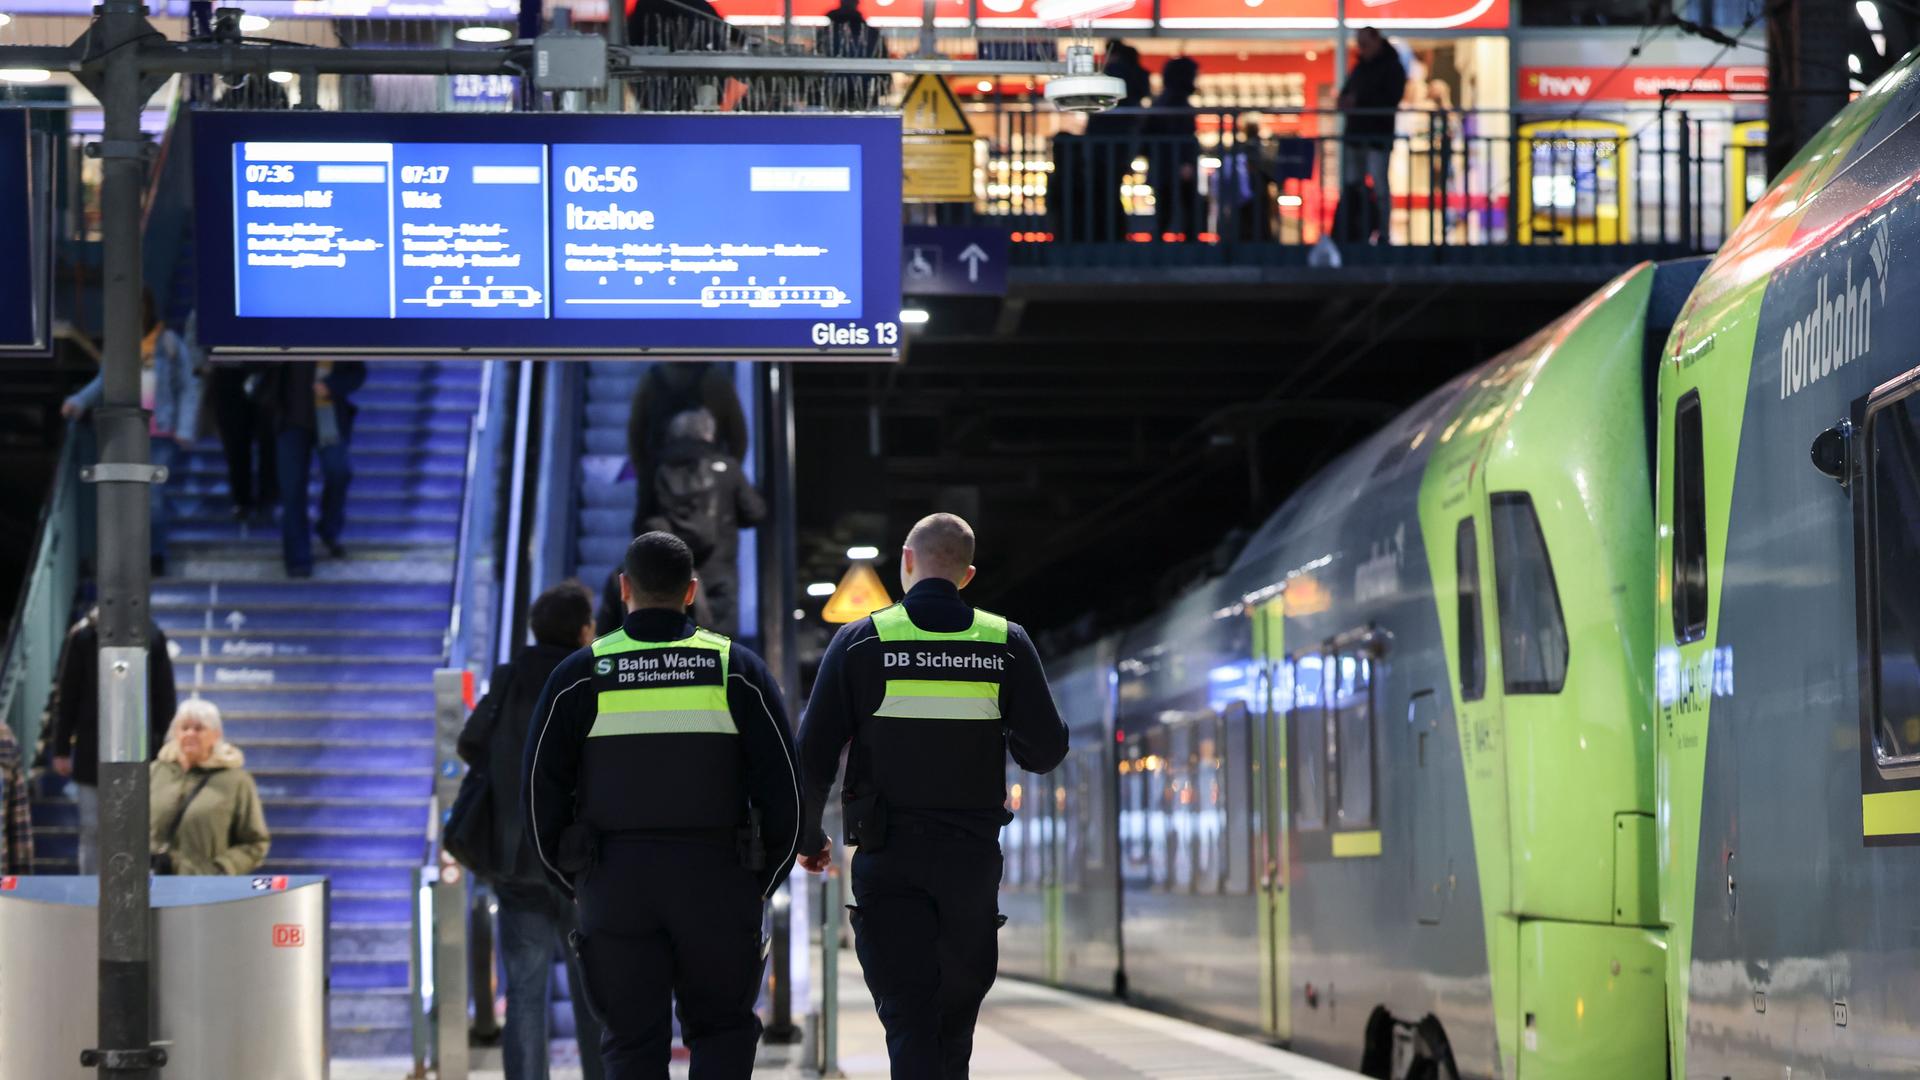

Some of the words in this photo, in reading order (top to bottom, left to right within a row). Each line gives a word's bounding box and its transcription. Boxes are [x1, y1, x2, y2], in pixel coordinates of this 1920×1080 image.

[1538, 73, 1592, 97] hvv
[245, 164, 295, 183] 07:36
[401, 165, 450, 184] 07:17
[564, 165, 638, 193] 06:56
[566, 202, 655, 231] Itzehoe
[811, 322, 870, 345] Gleis
[874, 322, 898, 345] 13
[1781, 256, 1871, 400] nordbahn
[618, 657, 659, 671] Bahn
[662, 652, 716, 668] Wache
[884, 651, 911, 668] DB
[915, 651, 1005, 671] Sicherheit
[618, 672, 636, 683] DB
[637, 670, 696, 683] Sicherheit
[275, 926, 302, 945] DB
